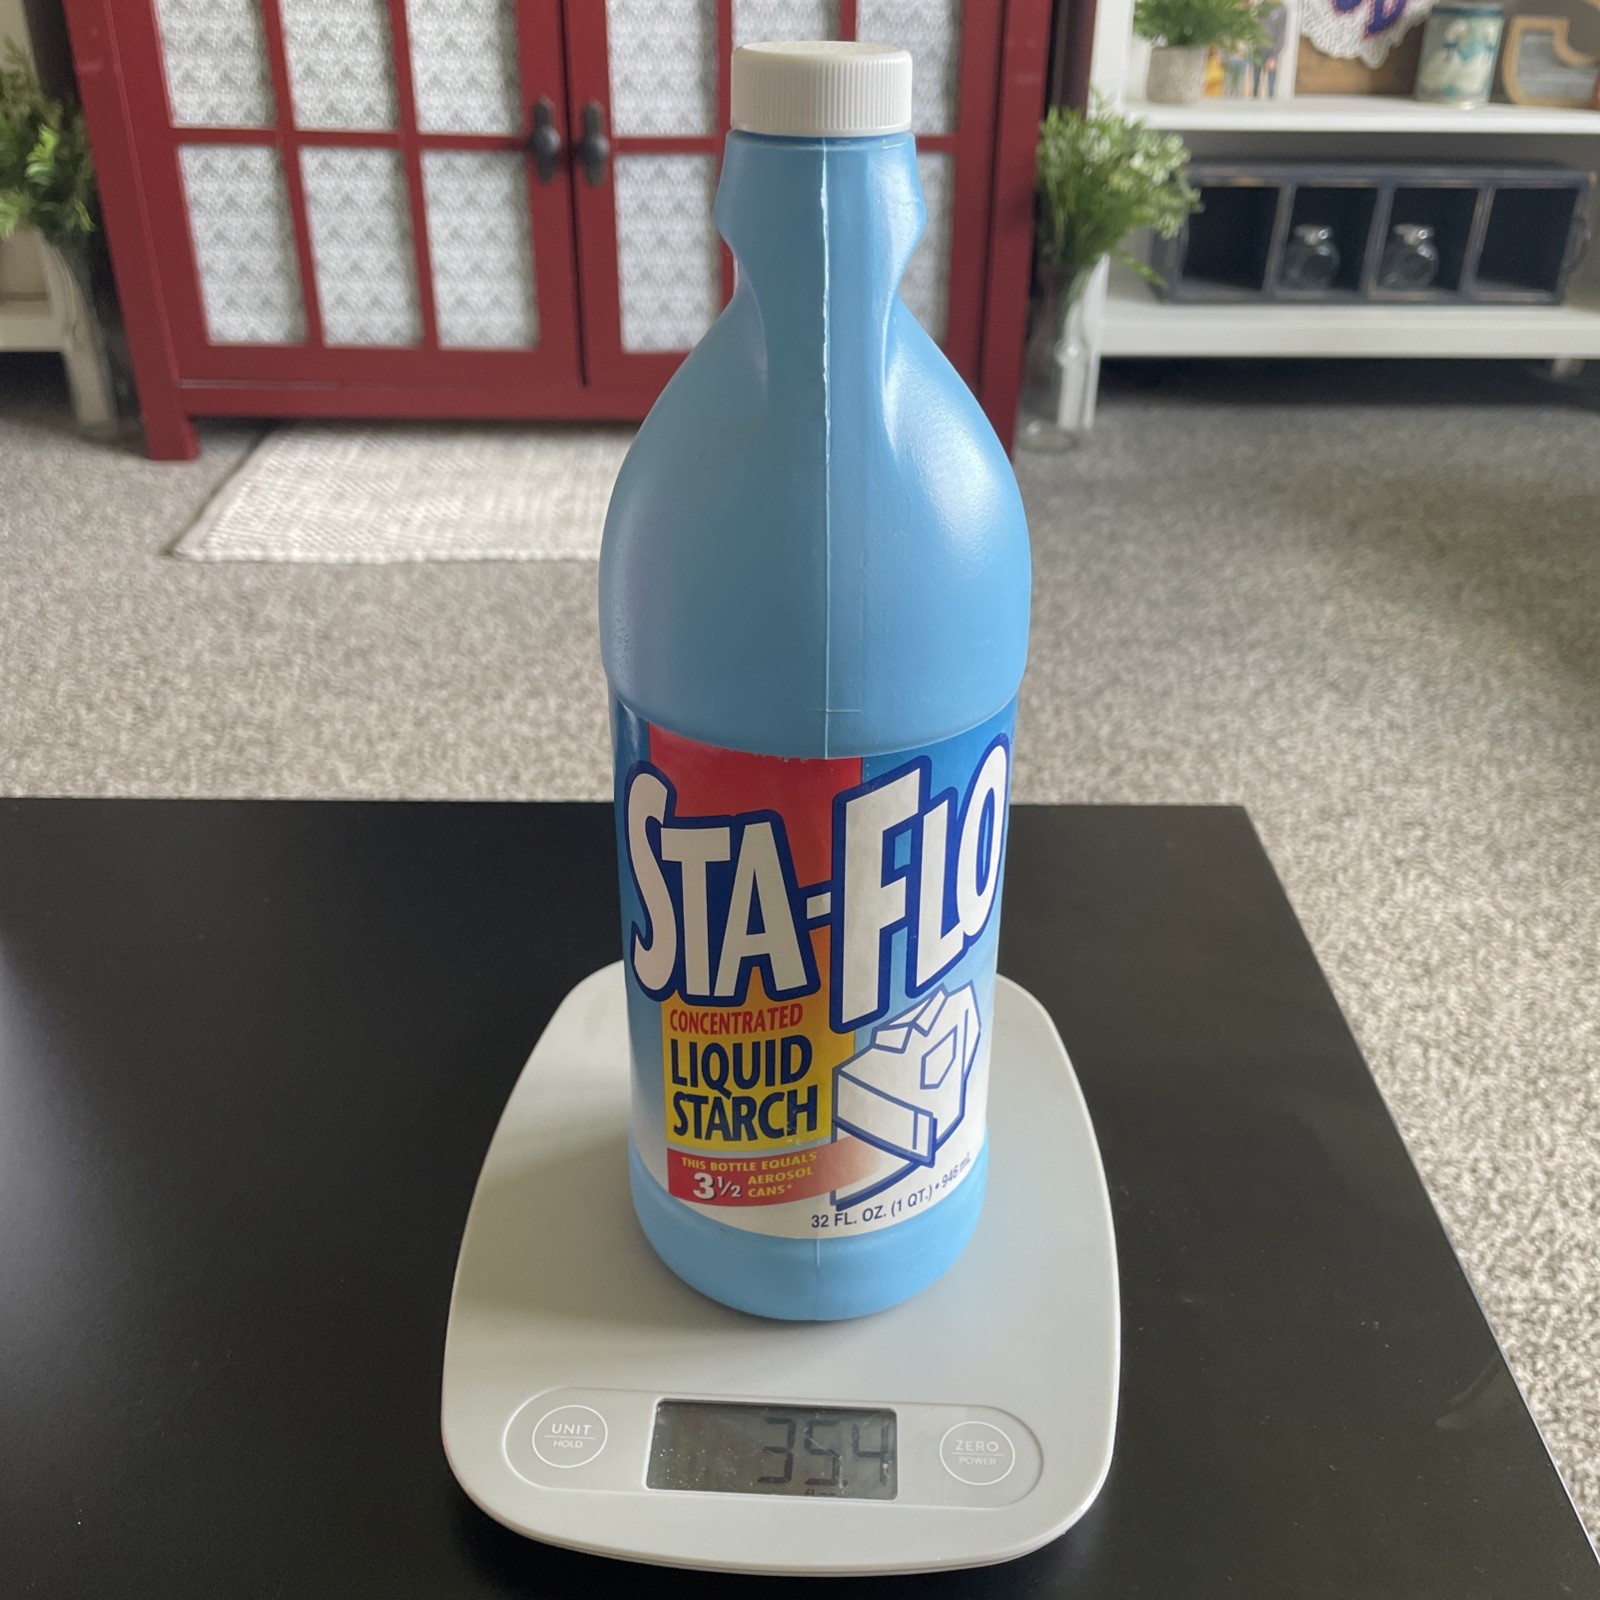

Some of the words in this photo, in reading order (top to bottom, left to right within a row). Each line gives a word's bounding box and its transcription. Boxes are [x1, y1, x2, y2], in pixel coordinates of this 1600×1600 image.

[625, 735, 1009, 1032] STA-FLO
[669, 1003, 803, 1035] CONCENTRATED
[670, 1035, 812, 1099] LIQUID
[673, 1085, 818, 1142] STARCH
[681, 1157, 706, 1170] THIS
[710, 1162, 757, 1172] BOTTLE
[761, 1151, 819, 1170] EQUALS
[747, 1167, 814, 1185] AEROSOL
[811, 1214, 829, 1228] 32
[834, 1213, 857, 1227] FL.
[862, 1205, 887, 1222] OZ.
[891, 1200, 902, 1217] (1
[907, 1184, 933, 1207] QT.)
[941, 1166, 959, 1188] 946
[551, 1423, 592, 1435] UNIT
[553, 1440, 583, 1448] HOLD
[757, 1417, 889, 1486] 35.4
[955, 1440, 999, 1452] ZERO
[959, 1456, 996, 1465] POWER
